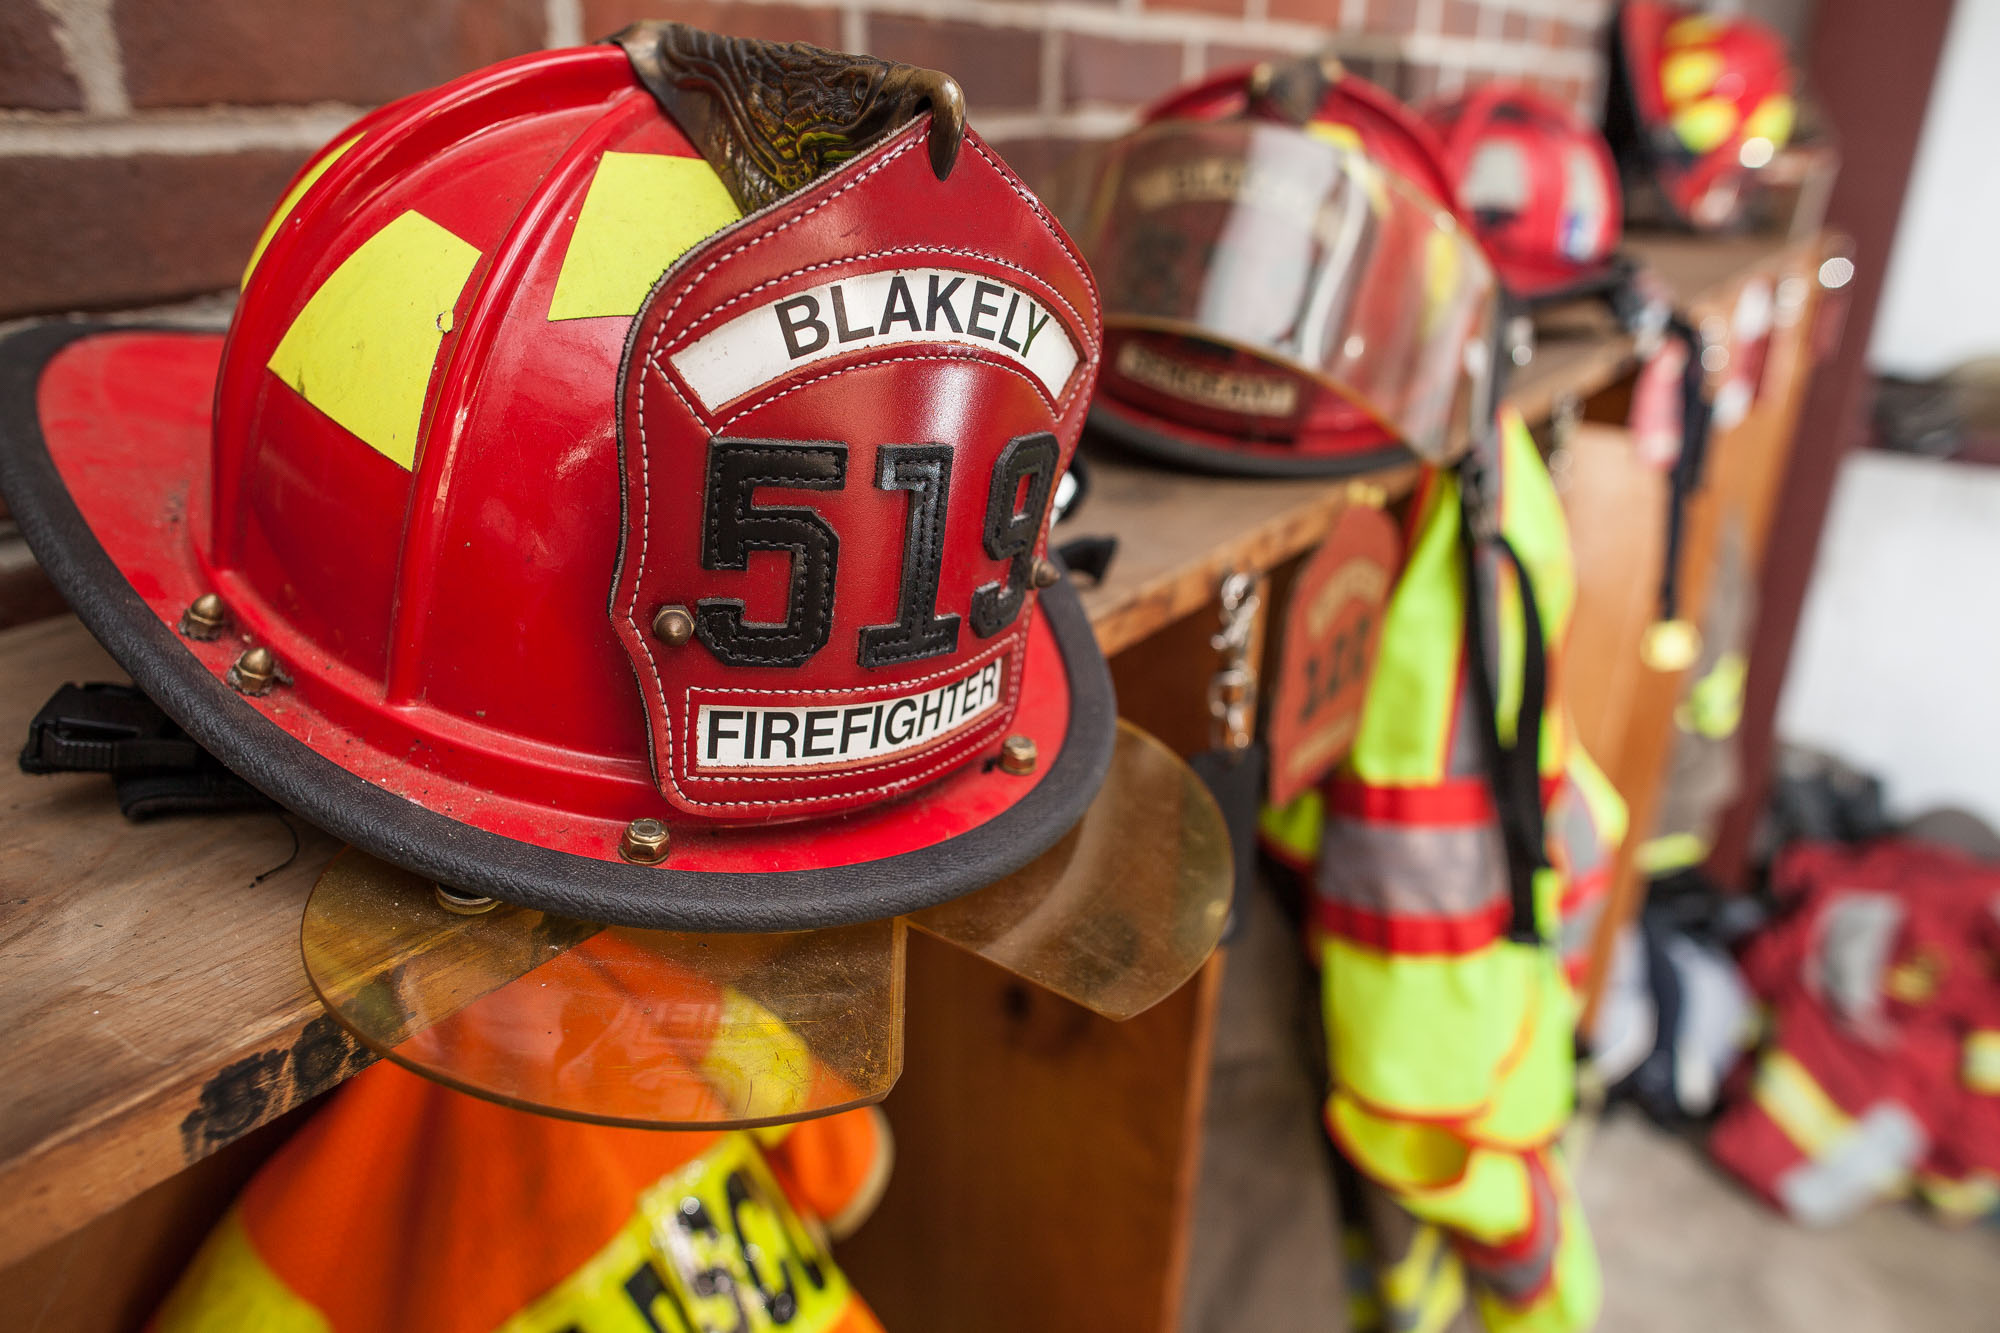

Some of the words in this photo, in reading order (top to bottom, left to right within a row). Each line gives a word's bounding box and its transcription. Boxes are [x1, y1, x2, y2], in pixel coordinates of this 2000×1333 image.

[773, 274, 1050, 360] BLAKELY
[697, 430, 1060, 668] 519
[707, 666, 997, 760] FIREFIGHTER
